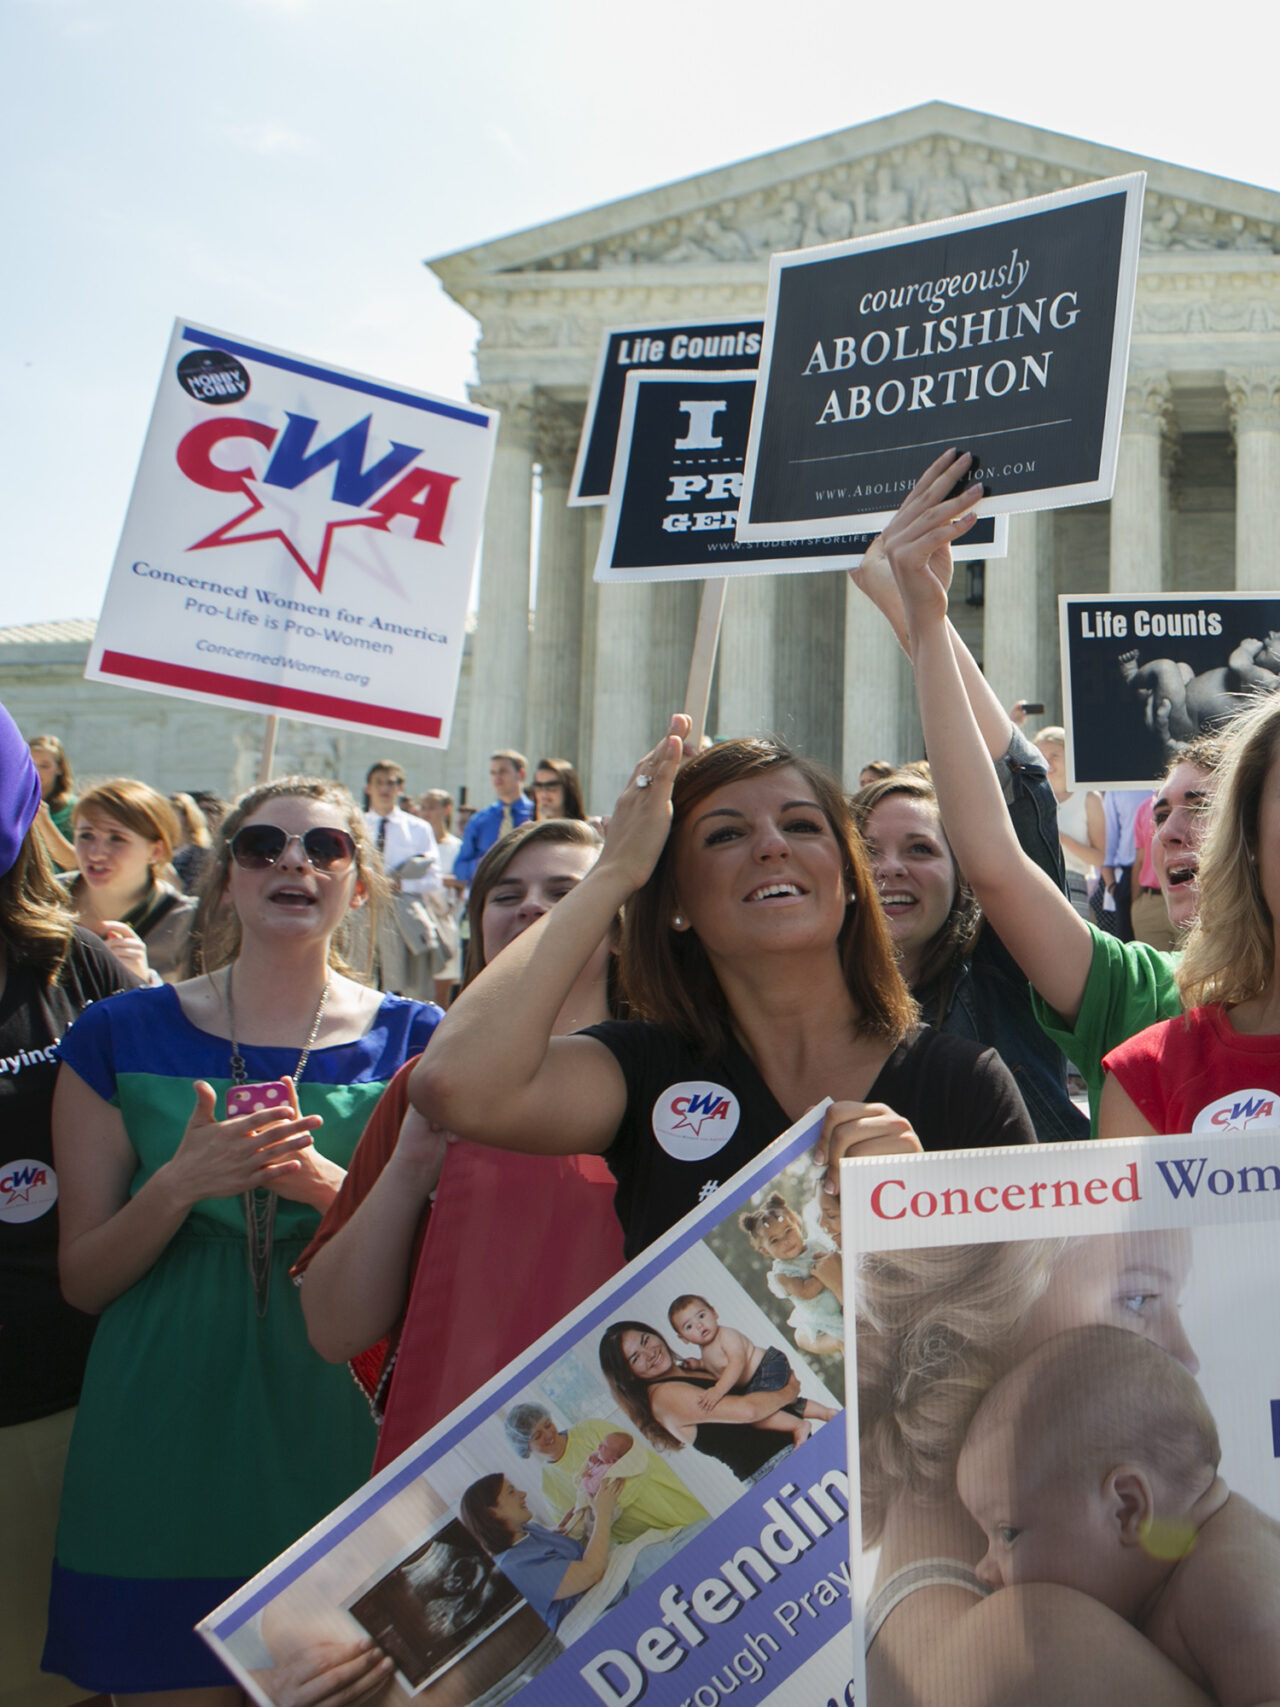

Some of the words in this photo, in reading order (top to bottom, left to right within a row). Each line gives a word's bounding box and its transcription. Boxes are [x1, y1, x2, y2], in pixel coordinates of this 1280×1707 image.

[859, 249, 1030, 315] courageously
[617, 337, 664, 365] Life
[670, 331, 762, 360] Counts
[801, 291, 1081, 376] ABOLISHING
[815, 351, 1053, 426] ABORTION
[674, 401, 727, 450] I
[176, 411, 461, 547] CWA
[707, 534, 883, 552] WWW.STUDENTSFORLIFE.
[132, 561, 248, 600] Concerned
[255, 588, 330, 619] Women
[337, 608, 364, 626] for
[372, 615, 448, 645] America
[184, 597, 259, 627] Pro-Life
[264, 613, 279, 631] is
[284, 619, 394, 656] Pro-Women
[1081, 611, 1128, 639] Life
[1134, 609, 1223, 638] Counts
[196, 638, 371, 687] ConcernedWomen.org
[671, 1091, 731, 1120] CWA
[1211, 1096, 1274, 1126] CWA
[0, 1166, 47, 1194] CWA
[870, 1162, 1142, 1220] Concerned
[579, 1469, 849, 1707] Defendin
[773, 1561, 852, 1637] Pray
